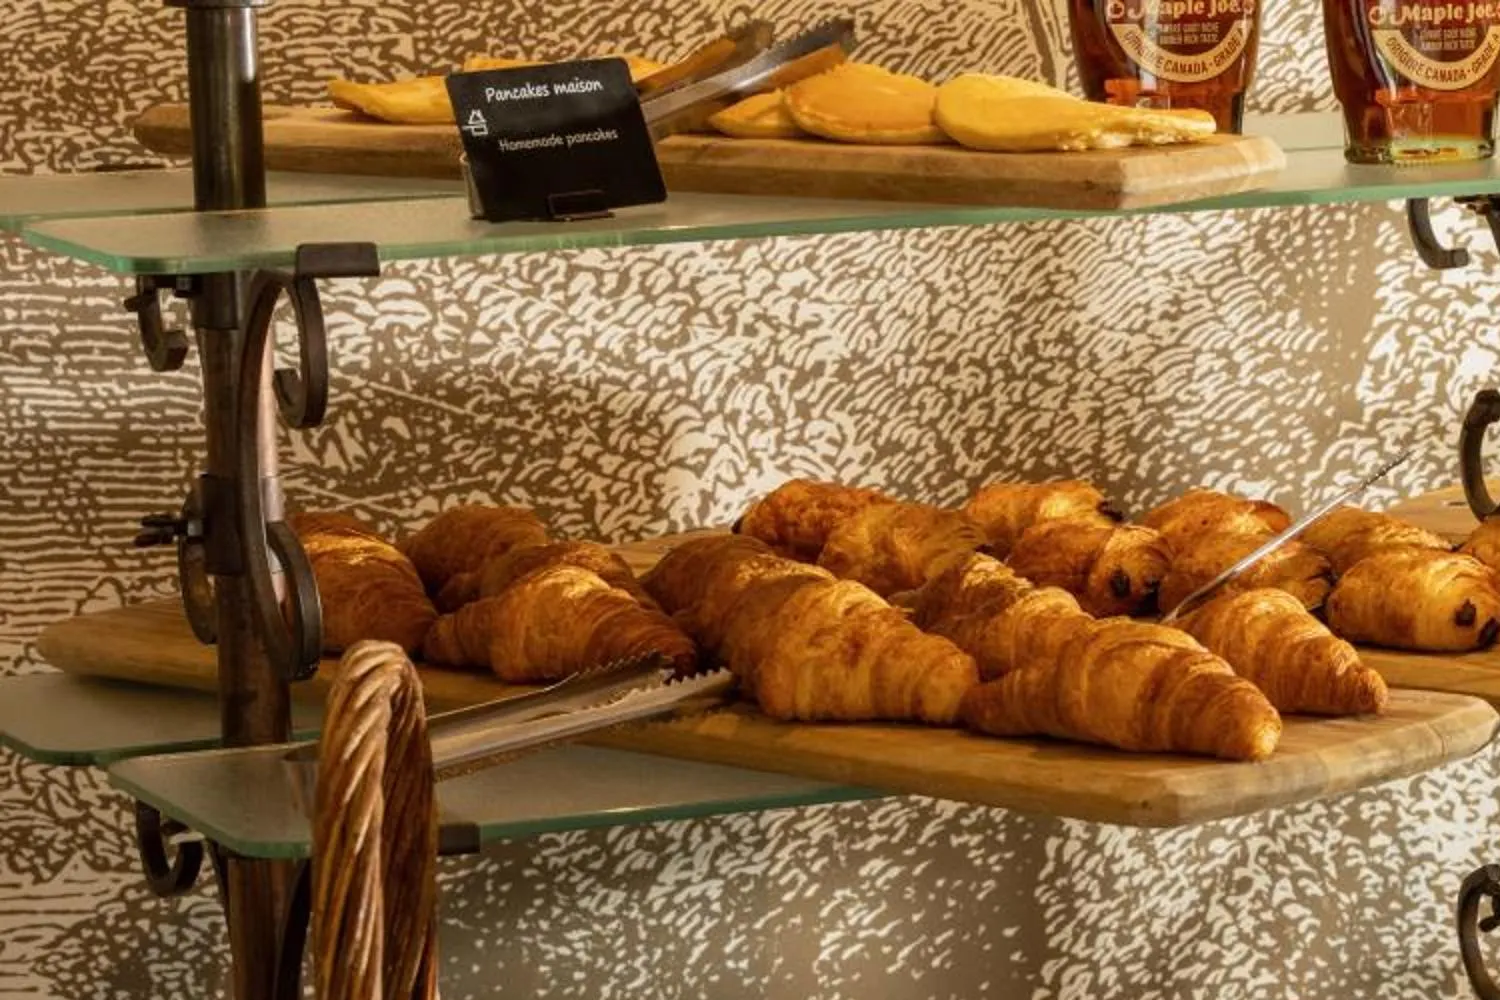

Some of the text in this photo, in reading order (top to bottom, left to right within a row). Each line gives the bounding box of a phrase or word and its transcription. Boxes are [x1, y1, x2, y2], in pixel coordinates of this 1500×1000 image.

[1390, 3, 1464, 25] Maple
[485, 77, 604, 103] Pancakes maison
[499, 128, 619, 152] Homemade pancakes
